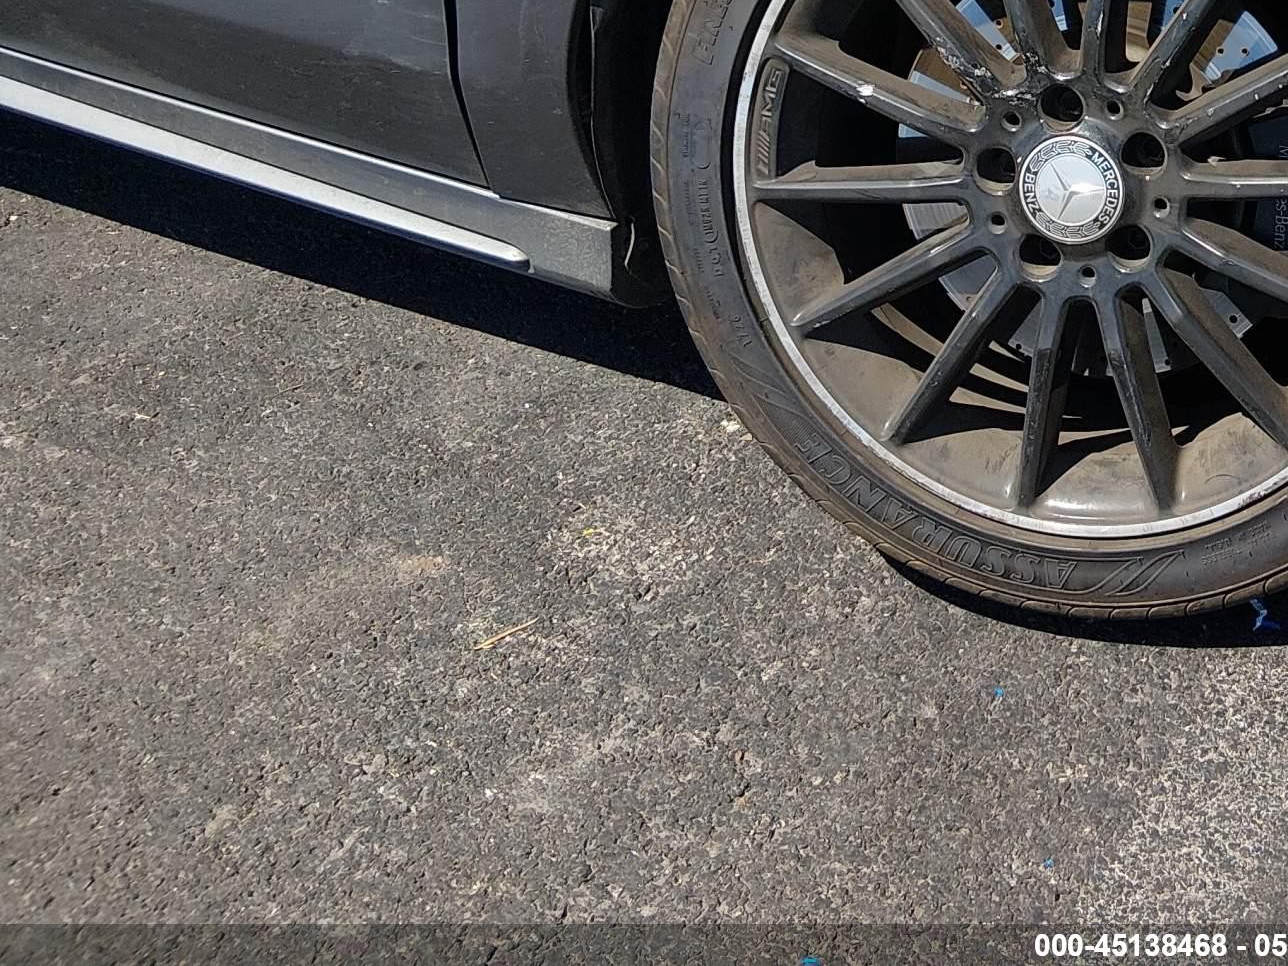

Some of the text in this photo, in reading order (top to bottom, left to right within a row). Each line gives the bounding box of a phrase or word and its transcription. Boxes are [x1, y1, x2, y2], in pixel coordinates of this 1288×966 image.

[1024, 173, 1039, 213] BENZ
[1091, 152, 1118, 225] MERCEDES
[794, 433, 1078, 589] ASSURANCE
